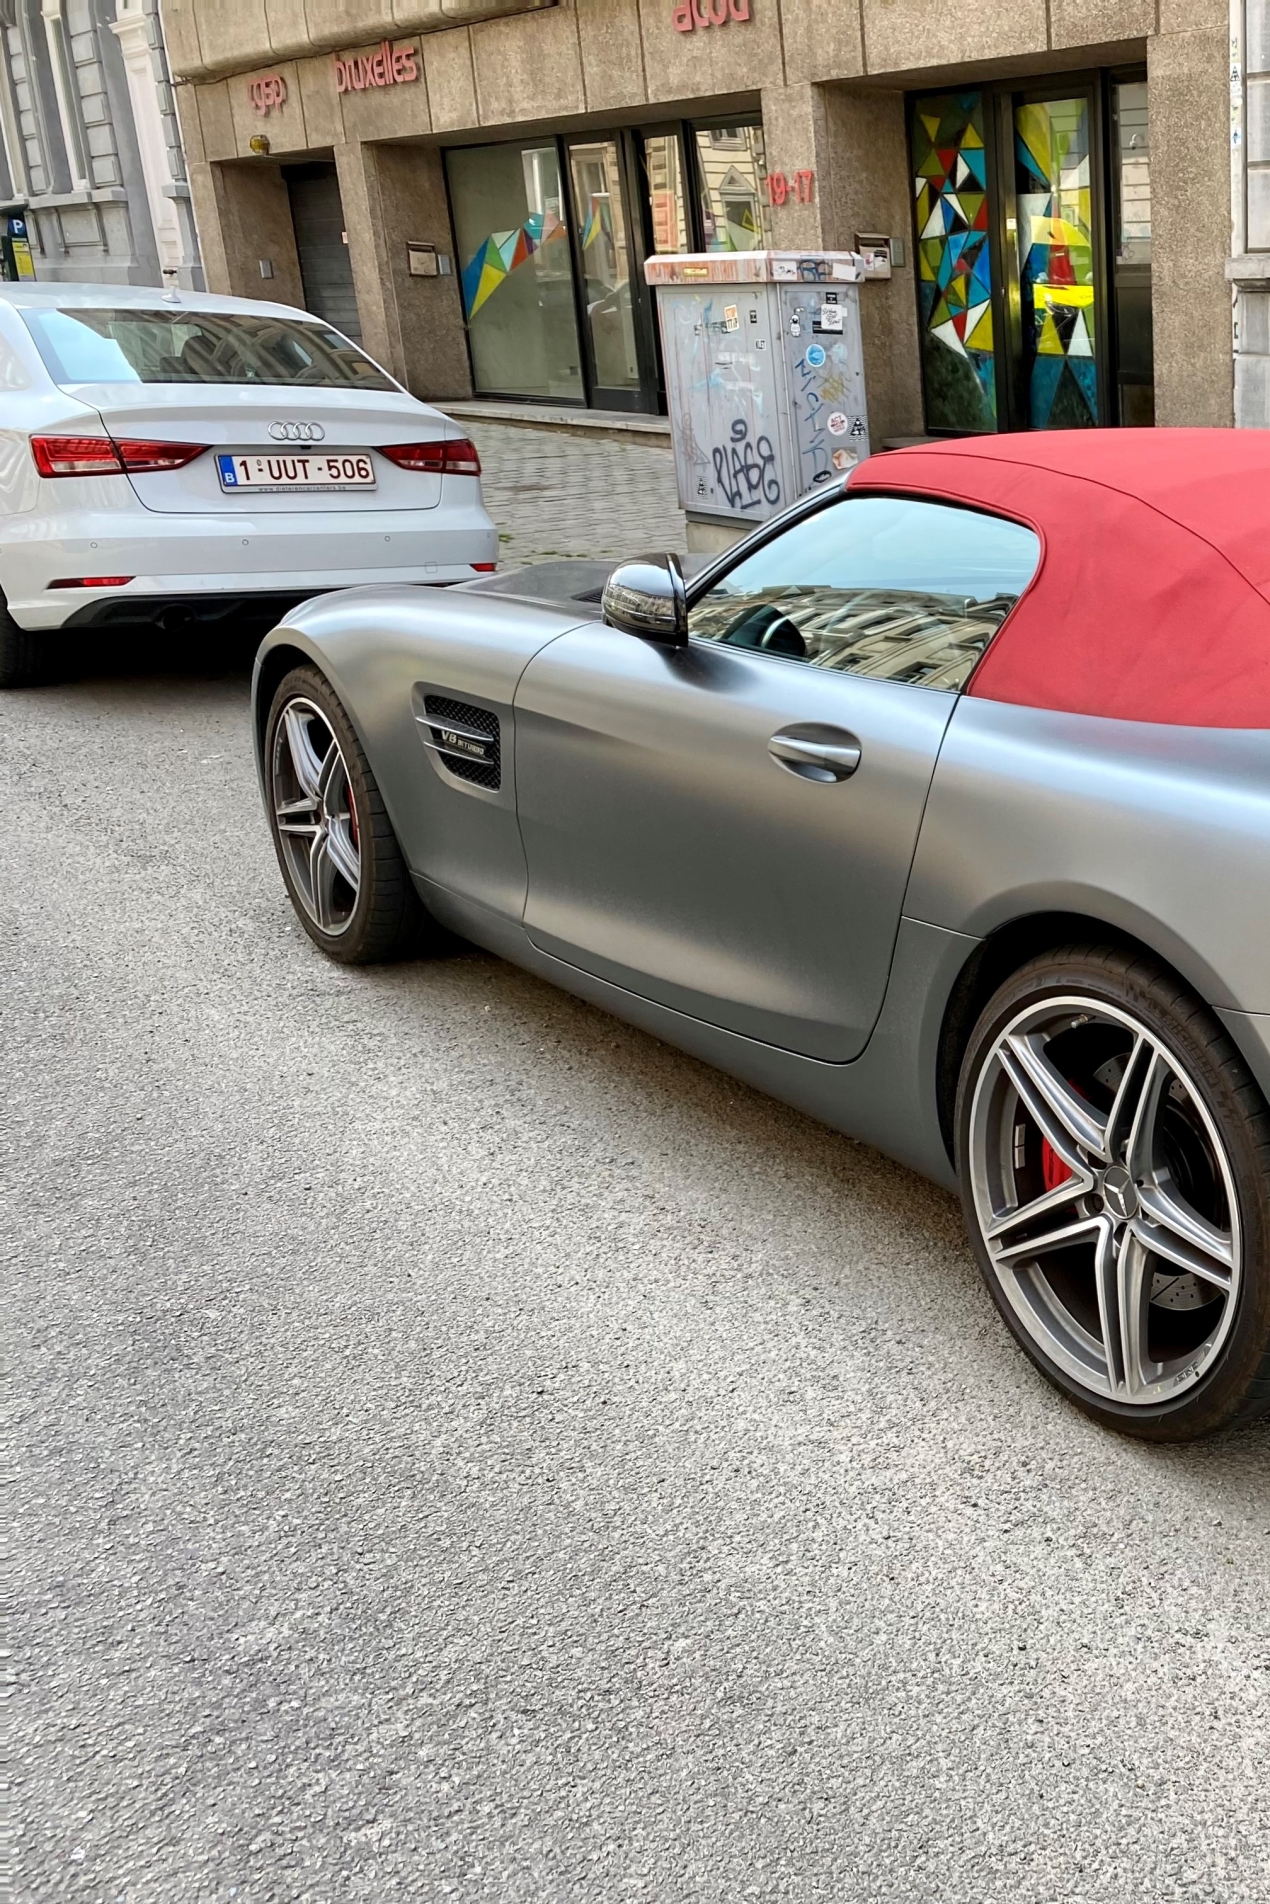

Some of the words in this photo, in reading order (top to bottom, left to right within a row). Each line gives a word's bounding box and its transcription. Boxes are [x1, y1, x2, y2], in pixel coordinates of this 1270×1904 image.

[332, 39, 417, 93] bruxelles
[766, 168, 813, 206] 19-17
[225, 472, 235, 483] B
[441, 730, 457, 743] V8
